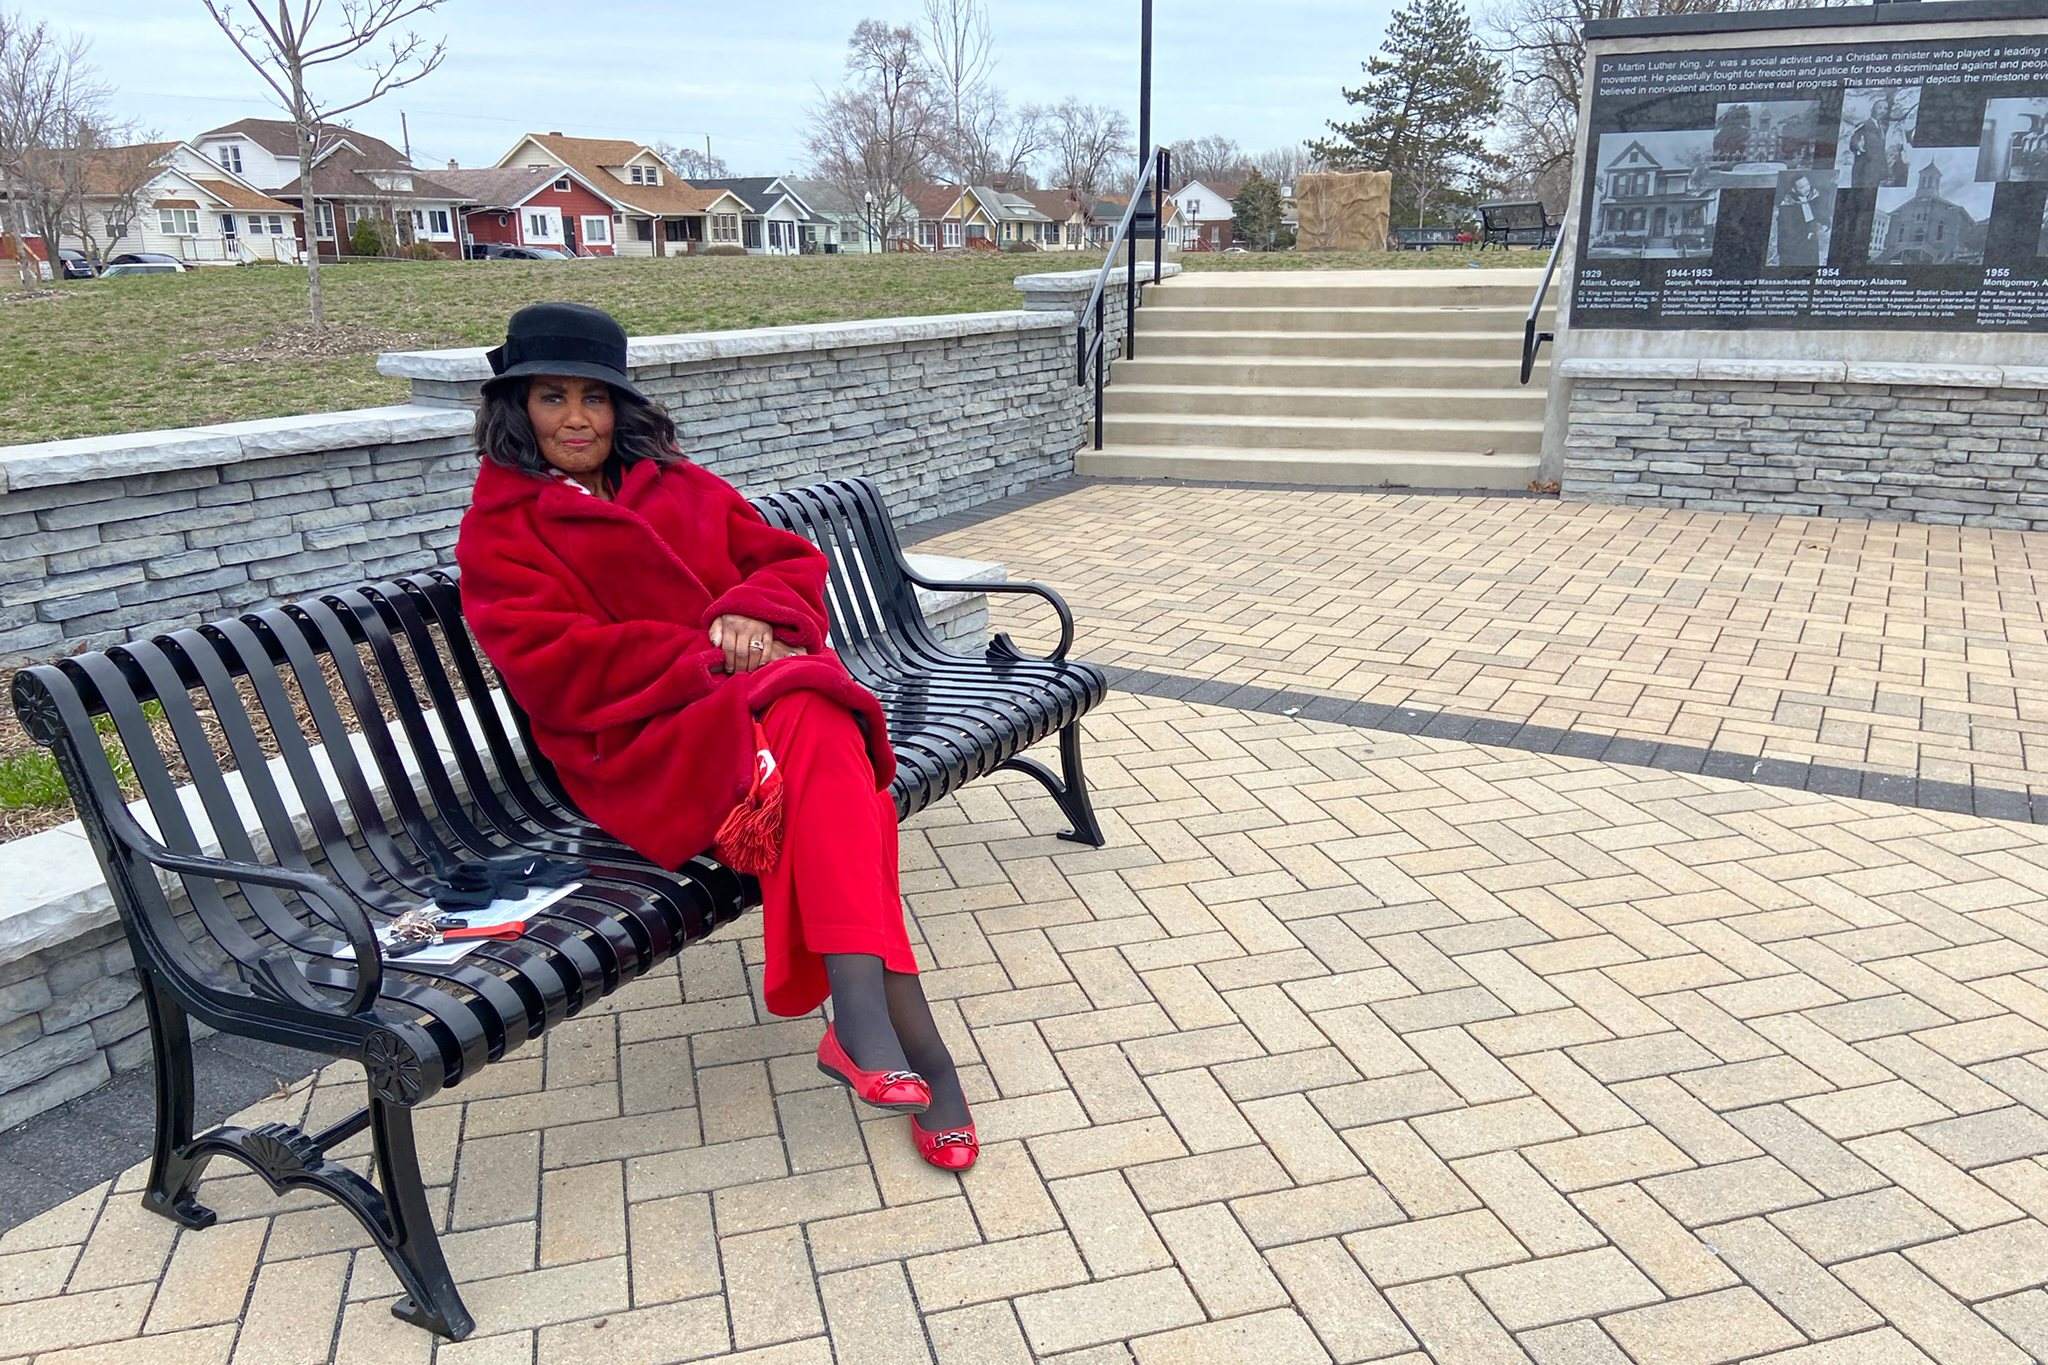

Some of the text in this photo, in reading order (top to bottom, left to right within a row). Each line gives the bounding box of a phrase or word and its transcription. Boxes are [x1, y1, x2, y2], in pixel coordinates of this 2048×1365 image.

[1602, 64, 1614, 72] Dr.
[1618, 62, 1645, 72] Martin
[1648, 61, 1676, 70] Luther
[1680, 60, 1702, 70] King,
[1706, 59, 1716, 68] Jr.
[1750, 57, 1777, 66] social
[1780, 55, 1812, 64] activist
[1815, 54, 1833, 63] and
[1846, 53, 1888, 62] Christian
[1891, 51, 1930, 60] minister
[1933, 50, 1954, 59] who
[1957, 48, 1991, 59] played
[2004, 46, 2041, 57] leading
[1601, 60, 2048, 84] movement. He peacefully fought for freedom and justice for those discriminated against and peop
[1600, 86, 1636, 96] believed
[1638, 85, 1646, 94] in
[1648, 84, 1697, 94] non-violent
[1699, 82, 1726, 92] action
[1729, 82, 1737, 91] to
[1739, 80, 1775, 90] achieve
[1777, 80, 1795, 89] real
[1797, 79, 1840, 90] progress.
[1843, 77, 1863, 86] This
[1866, 76, 1902, 86] timeline
[1905, 75, 1924, 84] wall
[1926, 74, 1961, 85] depicts
[1964, 74, 1980, 82] the
[1982, 72, 2030, 81] milestone
[1581, 270, 1602, 278] 1929
[1666, 269, 1713, 277] 1944-1953
[1817, 268, 1840, 277] 1954
[1986, 268, 2010, 277] 1955
[1610, 279, 1641, 288] Georgia
[1664, 279, 1693, 287] Georgia,
[1694, 279, 1742, 287] Pennsylvania,
[1815, 278, 1907, 287] Montgomery, Alabama
[1983, 278, 2040, 288] Montgomery,
